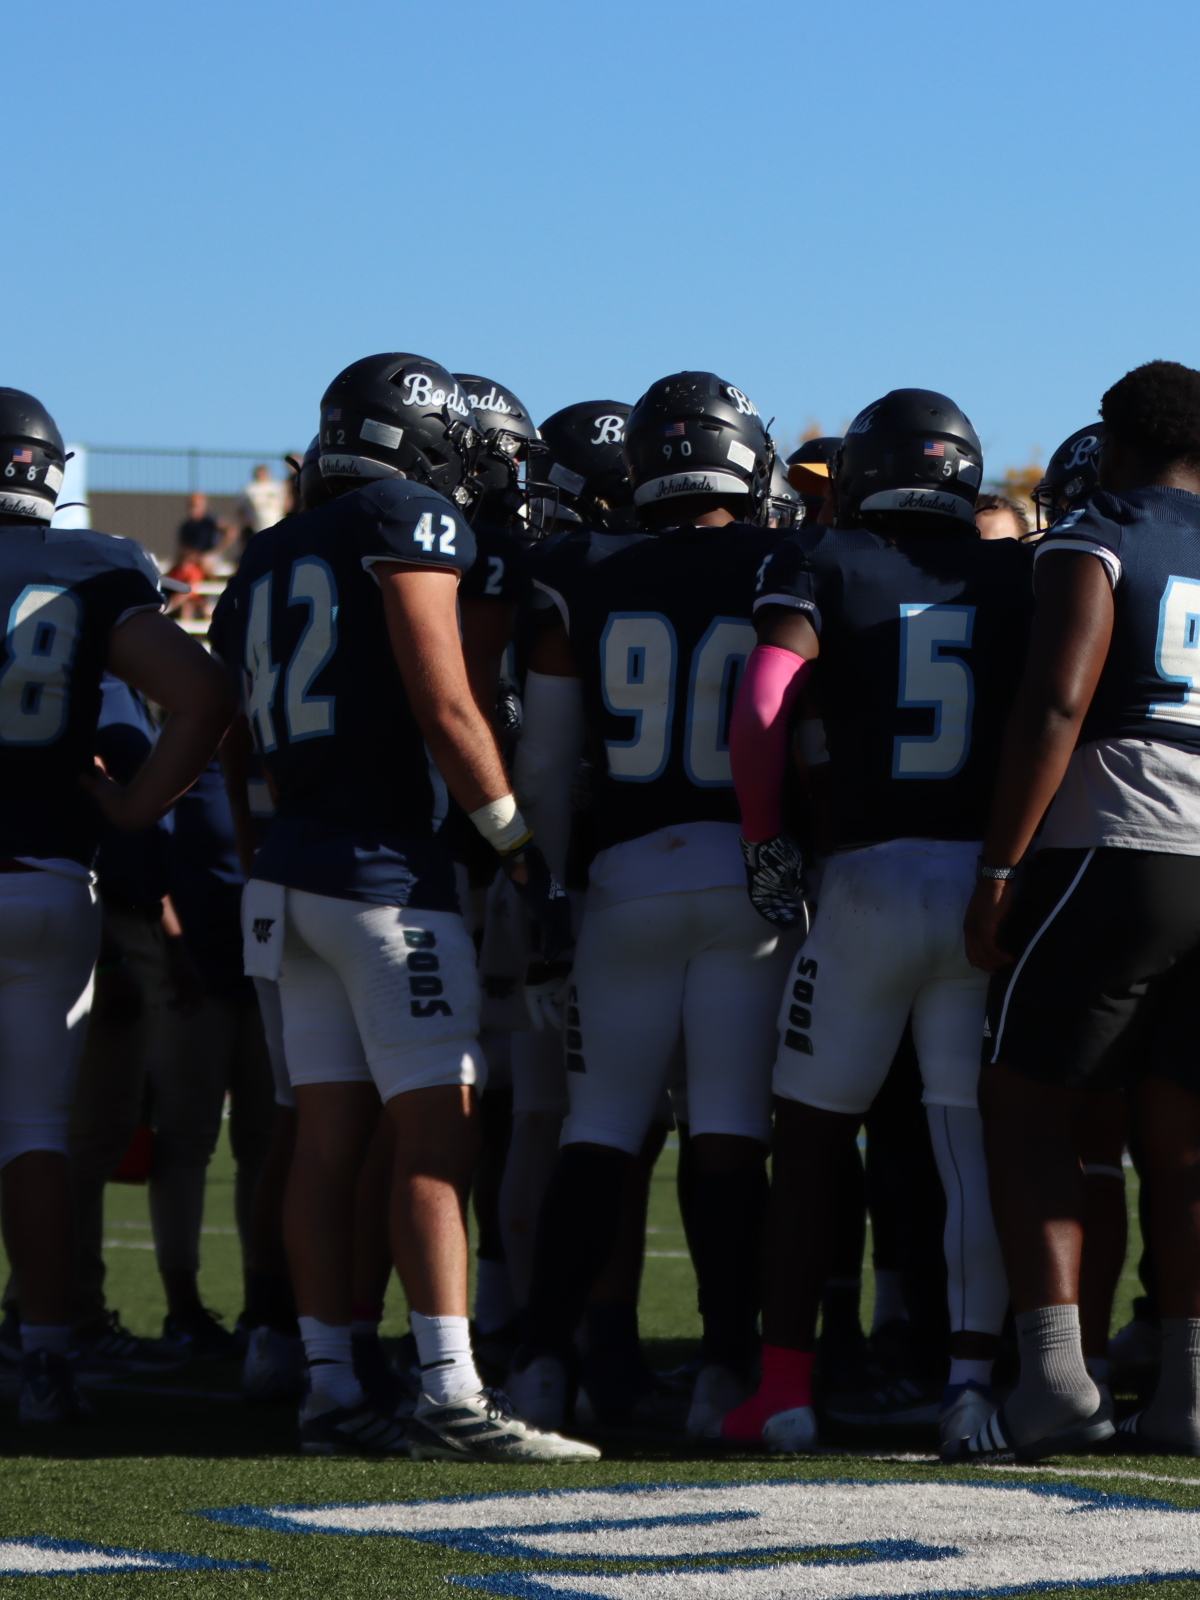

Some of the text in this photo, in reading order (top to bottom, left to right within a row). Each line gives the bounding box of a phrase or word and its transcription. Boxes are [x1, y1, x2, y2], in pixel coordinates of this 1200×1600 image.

[402, 373, 469, 417] Bods
[467, 387, 511, 414] ods
[324, 429, 346, 446] 42
[591, 415, 626, 445] B
[662, 440, 693, 461] 90
[942, 460, 953, 477] 5
[655, 476, 714, 499] Ichabods
[899, 491, 958, 515] Ichabods
[413, 512, 456, 556] 42
[245, 553, 340, 755] 42
[598, 610, 756, 789] 90
[891, 603, 978, 780] 5
[402, 930, 453, 1018] BODS
[784, 956, 818, 1057] BODS
[973, 1452, 1017, 1465] adidas
